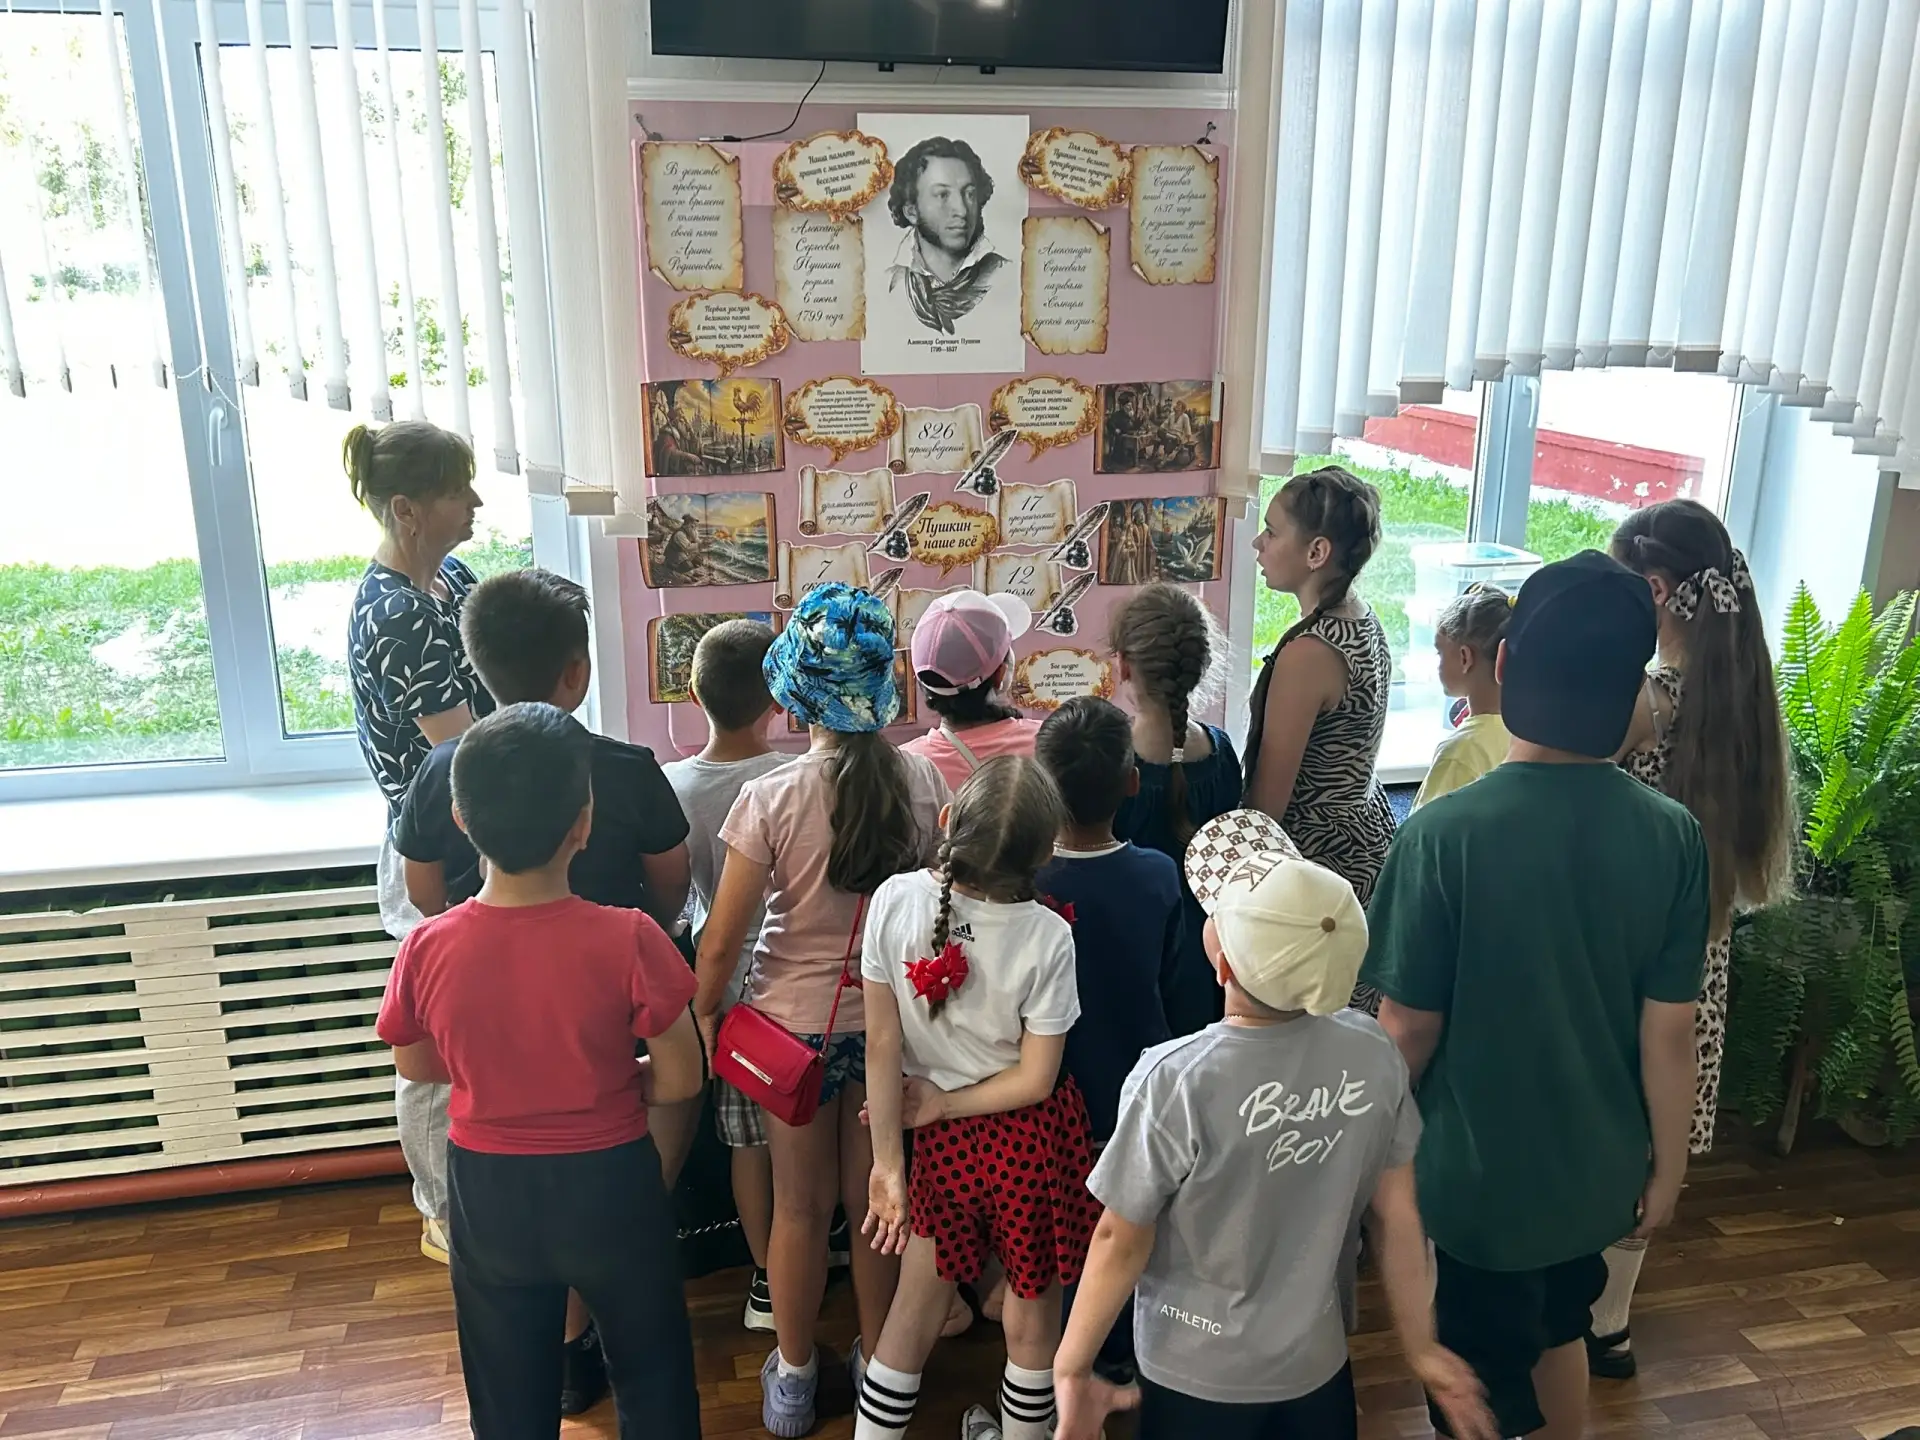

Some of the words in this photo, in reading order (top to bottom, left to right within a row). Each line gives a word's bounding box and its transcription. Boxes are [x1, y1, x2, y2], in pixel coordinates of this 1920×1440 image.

[1053, 148, 1077, 160] Пушкин
[1068, 141, 1081, 151] Для
[1082, 146, 1099, 156] меня
[808, 154, 828, 164] Наша
[829, 150, 855, 160] память
[664, 161, 678, 176] В
[682, 163, 720, 180] детстве
[799, 167, 822, 180] хранит
[1049, 159, 1087, 173] произведение
[1148, 160, 1196, 176] Александр
[1052, 169, 1069, 181] вроде
[672, 179, 712, 196] проводил
[824, 184, 852, 198] Пушкин
[1153, 175, 1192, 192] Сергеевич
[688, 193, 725, 211] времени
[1165, 192, 1176, 200] 10
[1178, 190, 1206, 203] февраля
[668, 208, 676, 222] в
[678, 214, 720, 222] компании
[1154, 204, 1174, 213] 1837
[1176, 207, 1192, 217] года
[671, 224, 692, 238] своей
[696, 230, 718, 238] няни
[790, 218, 844, 238] Александр
[675, 240, 712, 259] Арины
[795, 236, 840, 256] Сергеевич
[1038, 240, 1092, 259] Александра
[1144, 242, 1160, 258] Ему
[1162, 244, 1179, 254] было
[1182, 242, 1198, 254] всего
[793, 256, 841, 276] Пушкин
[1043, 259, 1086, 277] Сергеевича
[1156, 258, 1168, 268] 37
[802, 278, 834, 292] родился
[1044, 278, 1083, 296] называли
[803, 292, 812, 304] 6
[813, 296, 838, 304] июня
[1042, 296, 1084, 310] «Солнцем
[704, 305, 727, 314] Первая
[727, 306, 750, 315] заслуга
[704, 314, 730, 322] великого
[796, 310, 824, 322] 1799
[825, 312, 844, 327] года
[1030, 318, 1062, 332] русской
[694, 334, 718, 342] умнеет
[907, 338, 934, 346] Александр
[960, 338, 980, 346] Пушкин
[715, 342, 744, 352] поумнеть
[1028, 387, 1041, 396] При
[1017, 396, 1046, 405] Пушкина
[1048, 396, 1074, 404] тотчас
[918, 422, 957, 440] 826
[908, 440, 965, 460] произведений
[843, 482, 858, 500] 8
[820, 500, 878, 515] драматических
[1020, 496, 1044, 512] 17
[825, 509, 877, 526] произведений
[1008, 512, 1057, 527] прозаических
[916, 517, 972, 538] Пушкин
[1008, 522, 1057, 538] произведений
[923, 538, 958, 550] наше
[958, 535, 978, 548] всё
[816, 560, 834, 579] 7
[1008, 565, 1036, 586] 12
[1061, 663, 1080, 671] щедро
[1034, 681, 1044, 689] дав
[1051, 690, 1077, 698] Пушкина
[1238, 1069, 1374, 1137] BRAVE
[1266, 1129, 1344, 1174] BOY
[1159, 1303, 1222, 1336] ATHLETIC
